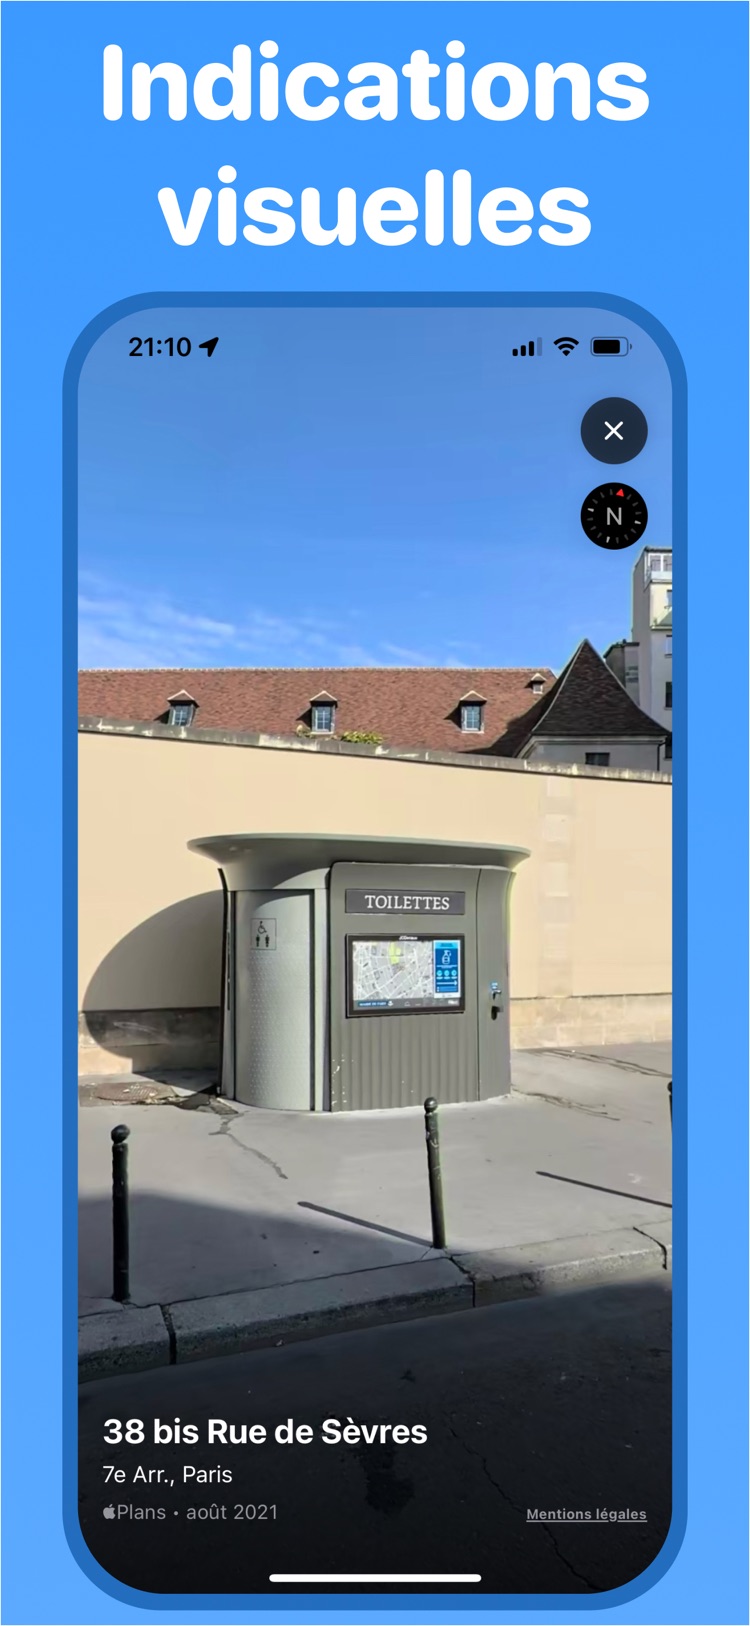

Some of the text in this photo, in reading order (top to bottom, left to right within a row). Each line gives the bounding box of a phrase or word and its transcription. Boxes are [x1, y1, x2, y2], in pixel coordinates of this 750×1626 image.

[128, 336, 192, 357] 21:10
[606, 508, 622, 526] N
[364, 895, 450, 911] TOILETTES
[103, 1416, 428, 1445] 38 bis Rue de Sèvres
[102, 1464, 233, 1487] 7e Arr., Paris
[117, 1503, 278, 1521] Plans août 2021
[526, 1508, 647, 1523] Mentions légales
